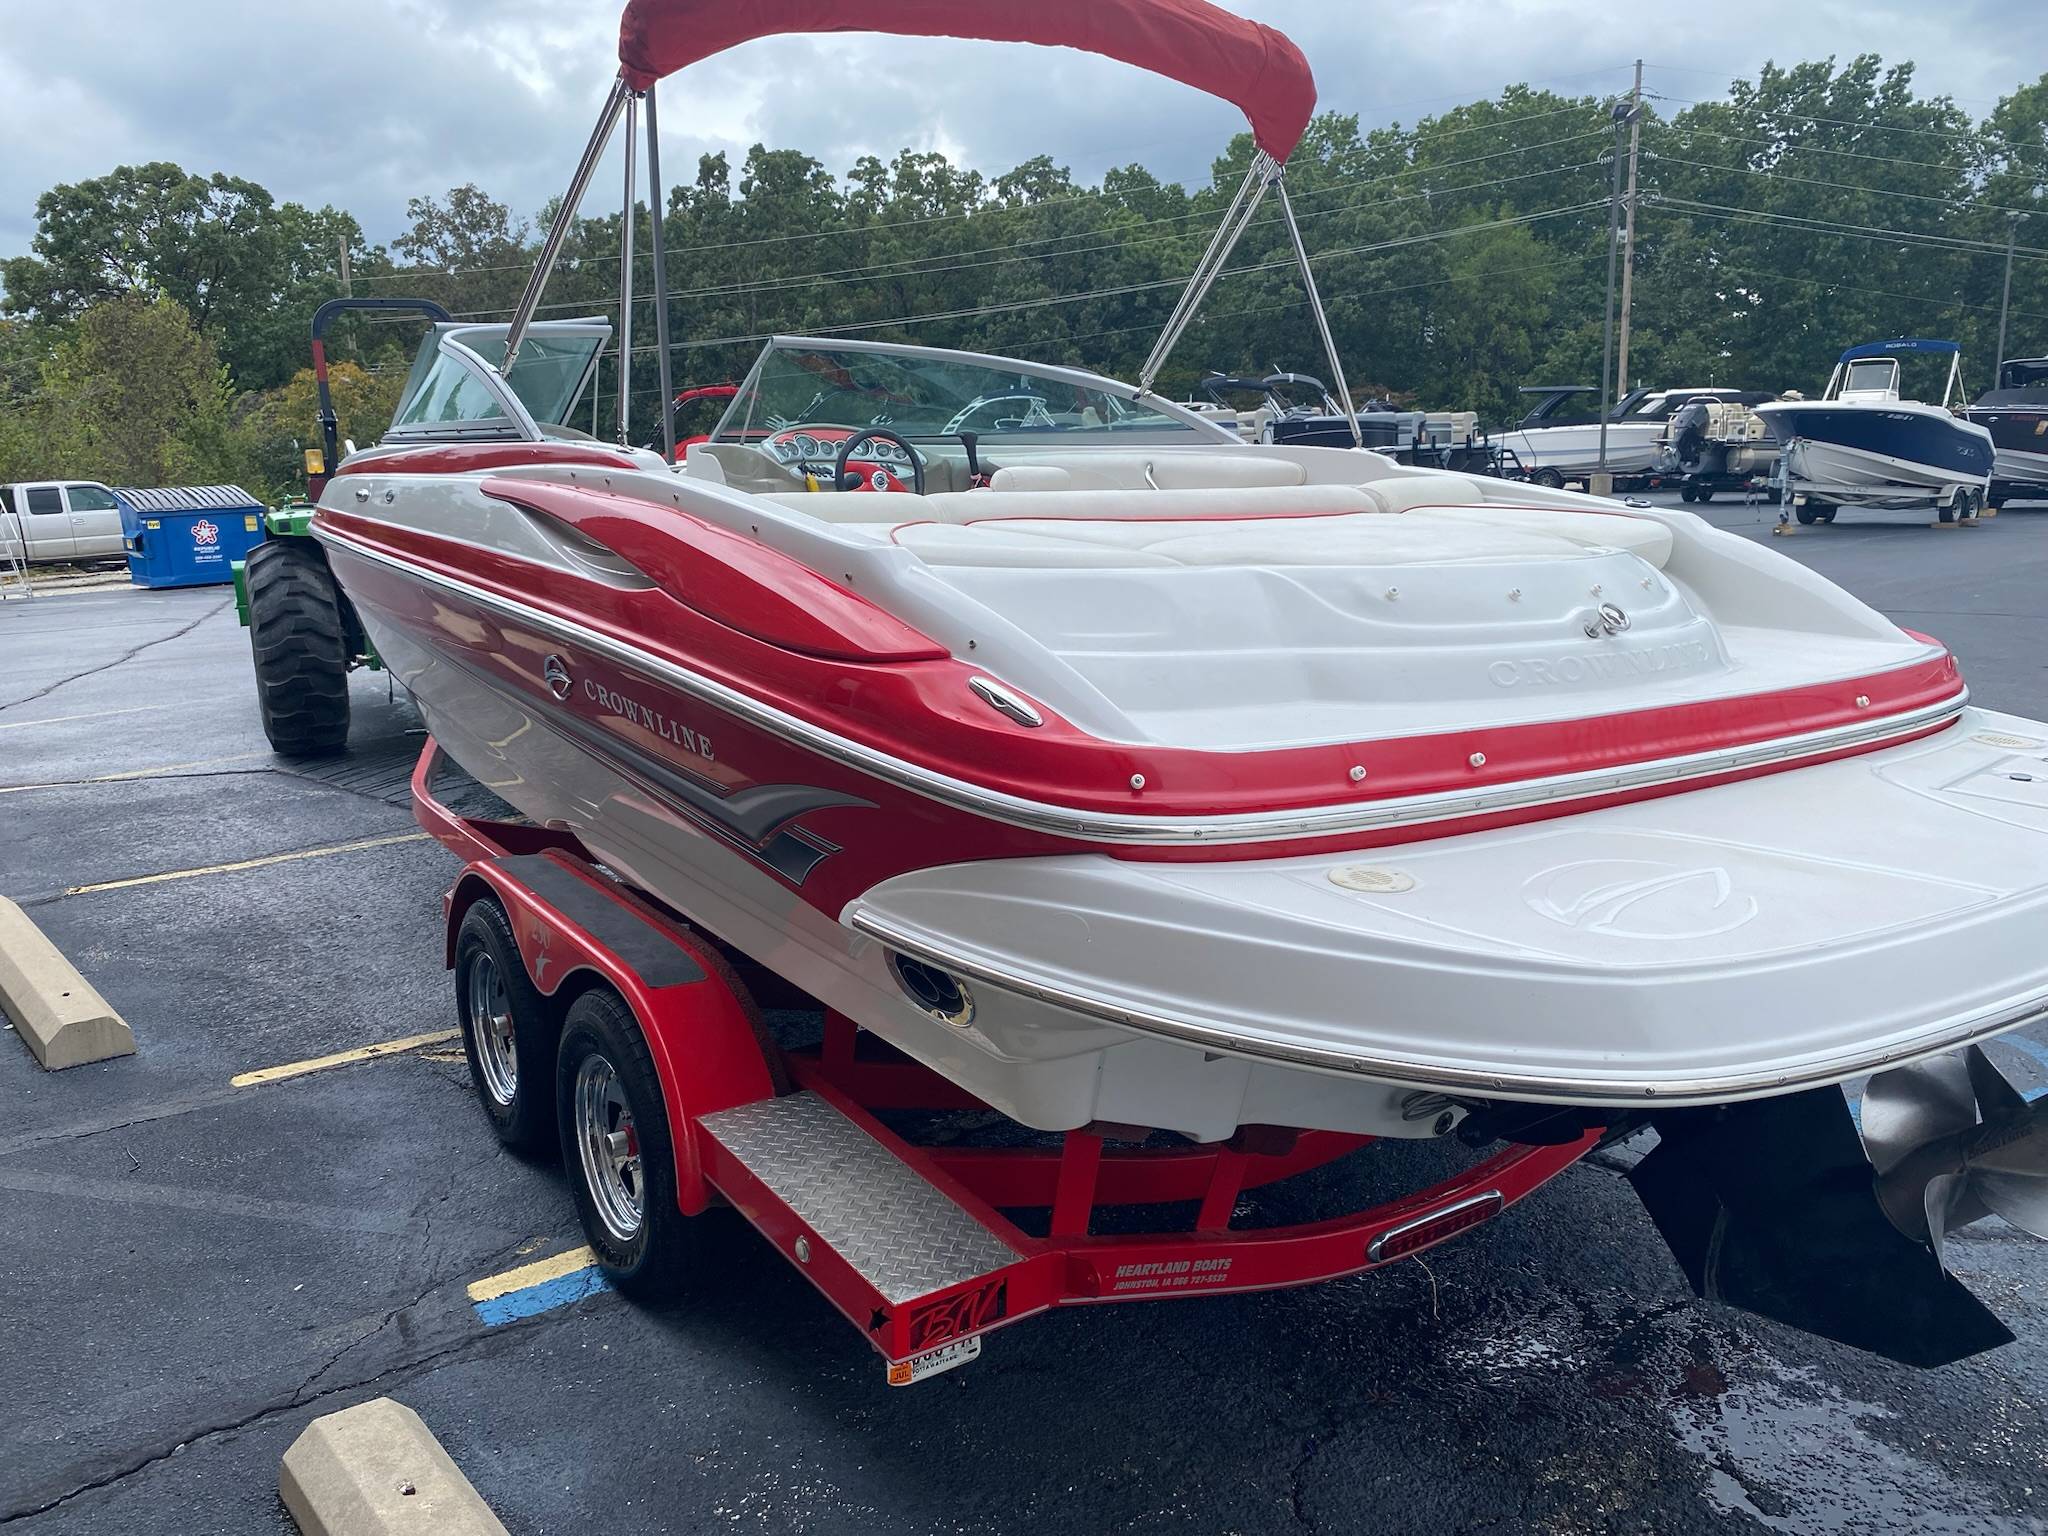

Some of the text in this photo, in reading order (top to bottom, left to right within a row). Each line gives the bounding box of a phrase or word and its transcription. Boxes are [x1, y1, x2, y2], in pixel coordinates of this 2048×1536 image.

[584, 678, 715, 761] CROWNLINE
[1115, 1258, 1232, 1277] HEARTLAND BOATS
[1113, 1280, 1159, 1290] JOHNSTON,
[1162, 1278, 1171, 1286] IA
[894, 1370, 909, 1380] JUL
